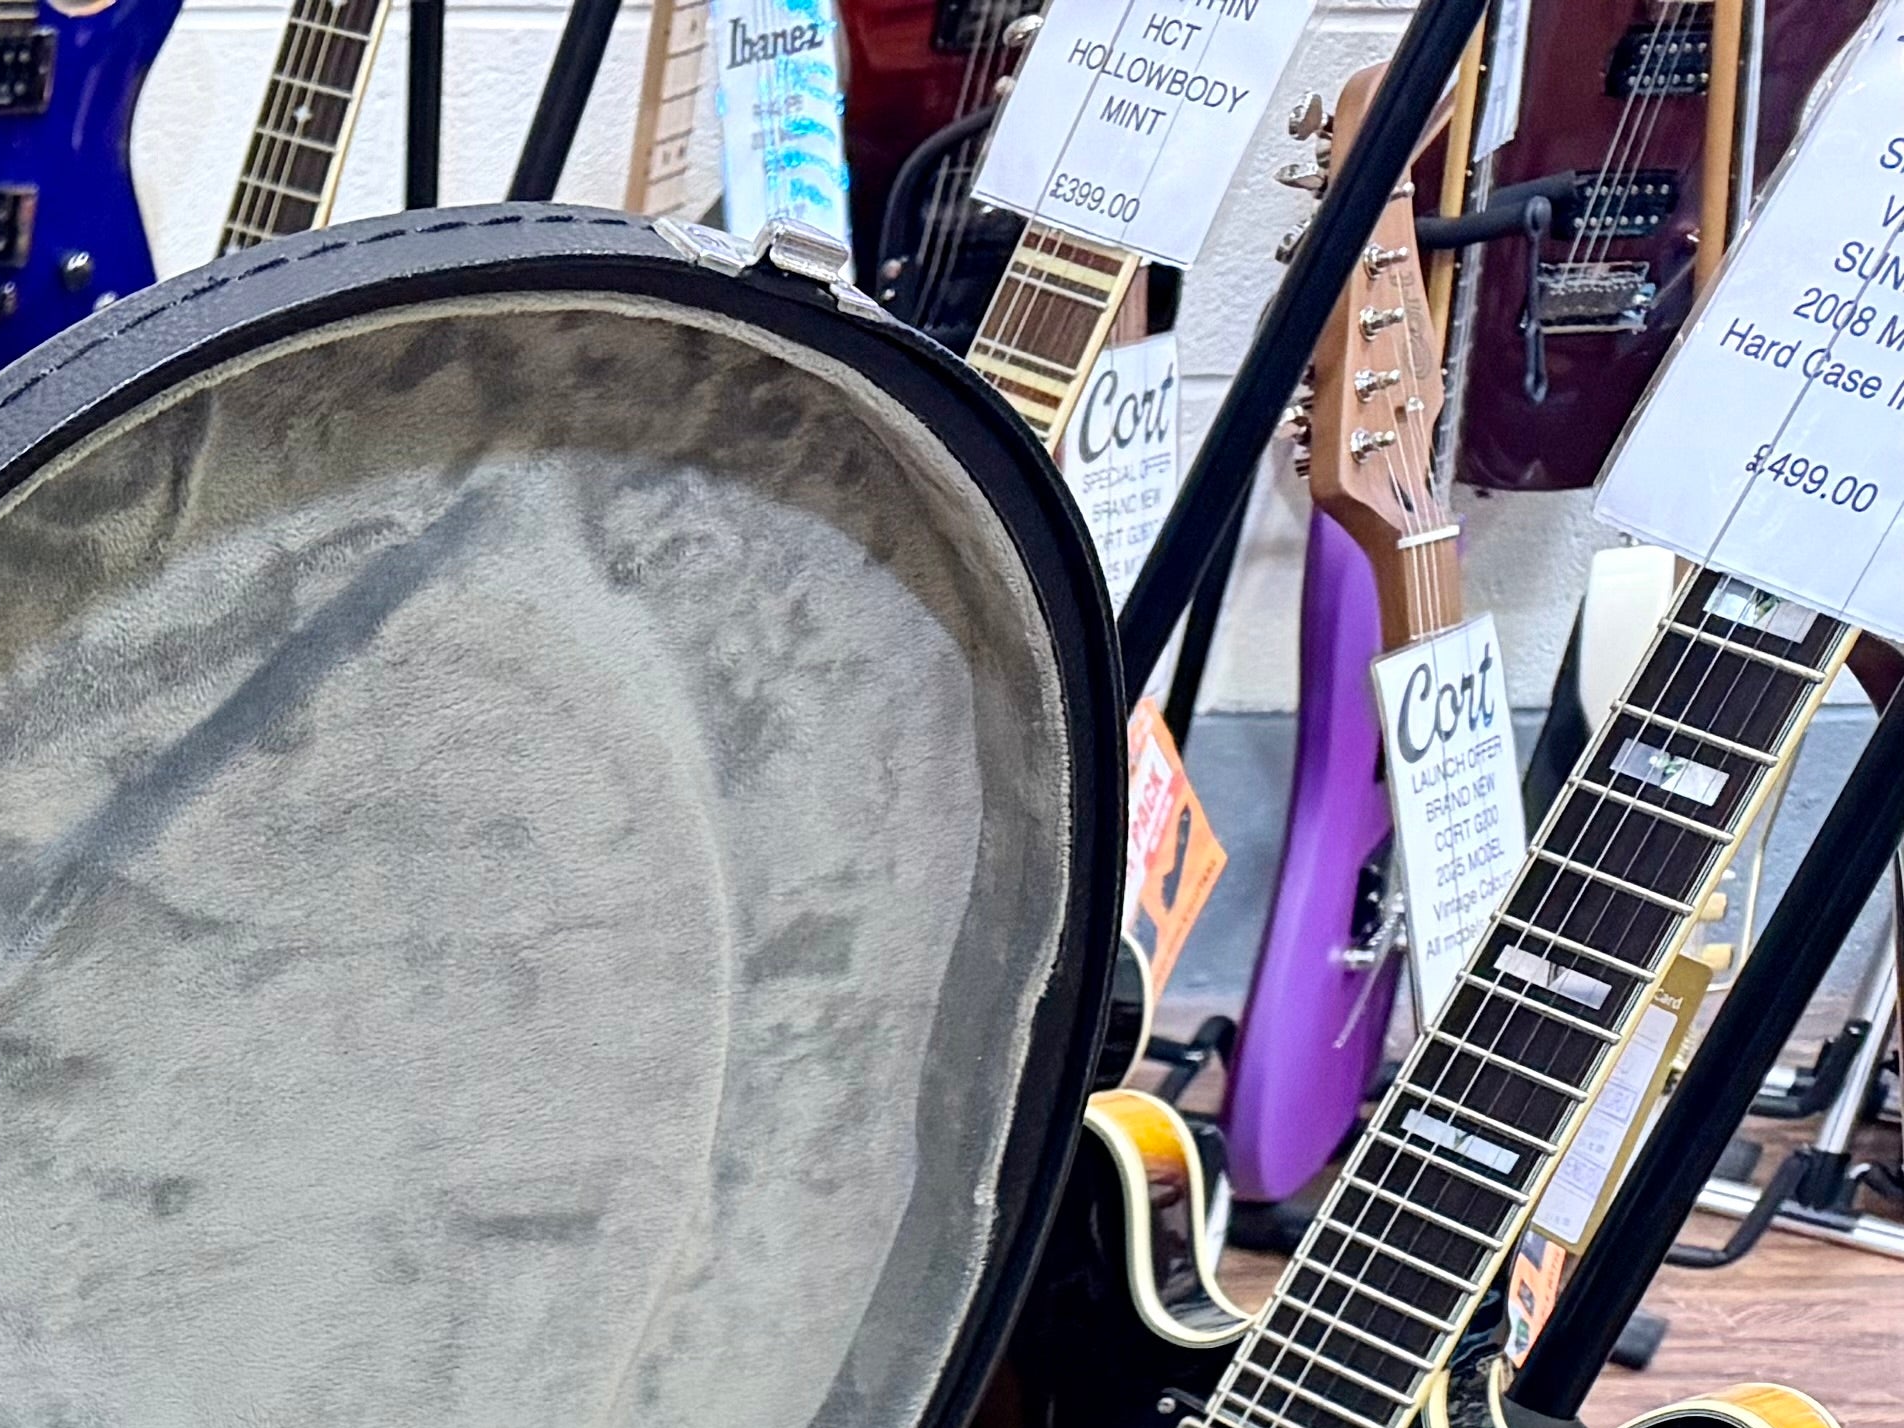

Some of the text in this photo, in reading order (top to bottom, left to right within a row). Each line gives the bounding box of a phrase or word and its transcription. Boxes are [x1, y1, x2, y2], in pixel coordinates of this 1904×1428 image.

[726, 17, 824, 70] Ibanez
[1142, 13, 1202, 51] HCT
[1068, 38, 1250, 114] HOLLOWBODY
[1099, 95, 1167, 135] MINT
[1049, 173, 1141, 223] £399.00
[1793, 287, 1877, 338] 2008
[1720, 317, 1802, 369] Hard
[1802, 348, 1882, 399] Case
[1078, 362, 1174, 464] Cort
[1745, 443, 1879, 513] £499.00
[1397, 642, 1495, 764] Cort
[1412, 735, 1503, 794] LAUNCH OFFER
[1426, 772, 1496, 822] BRAND NEW
[1435, 818, 1472, 852] CORT
[1468, 837, 1505, 874] MODEL
[1433, 889, 1478, 922] Vintage
